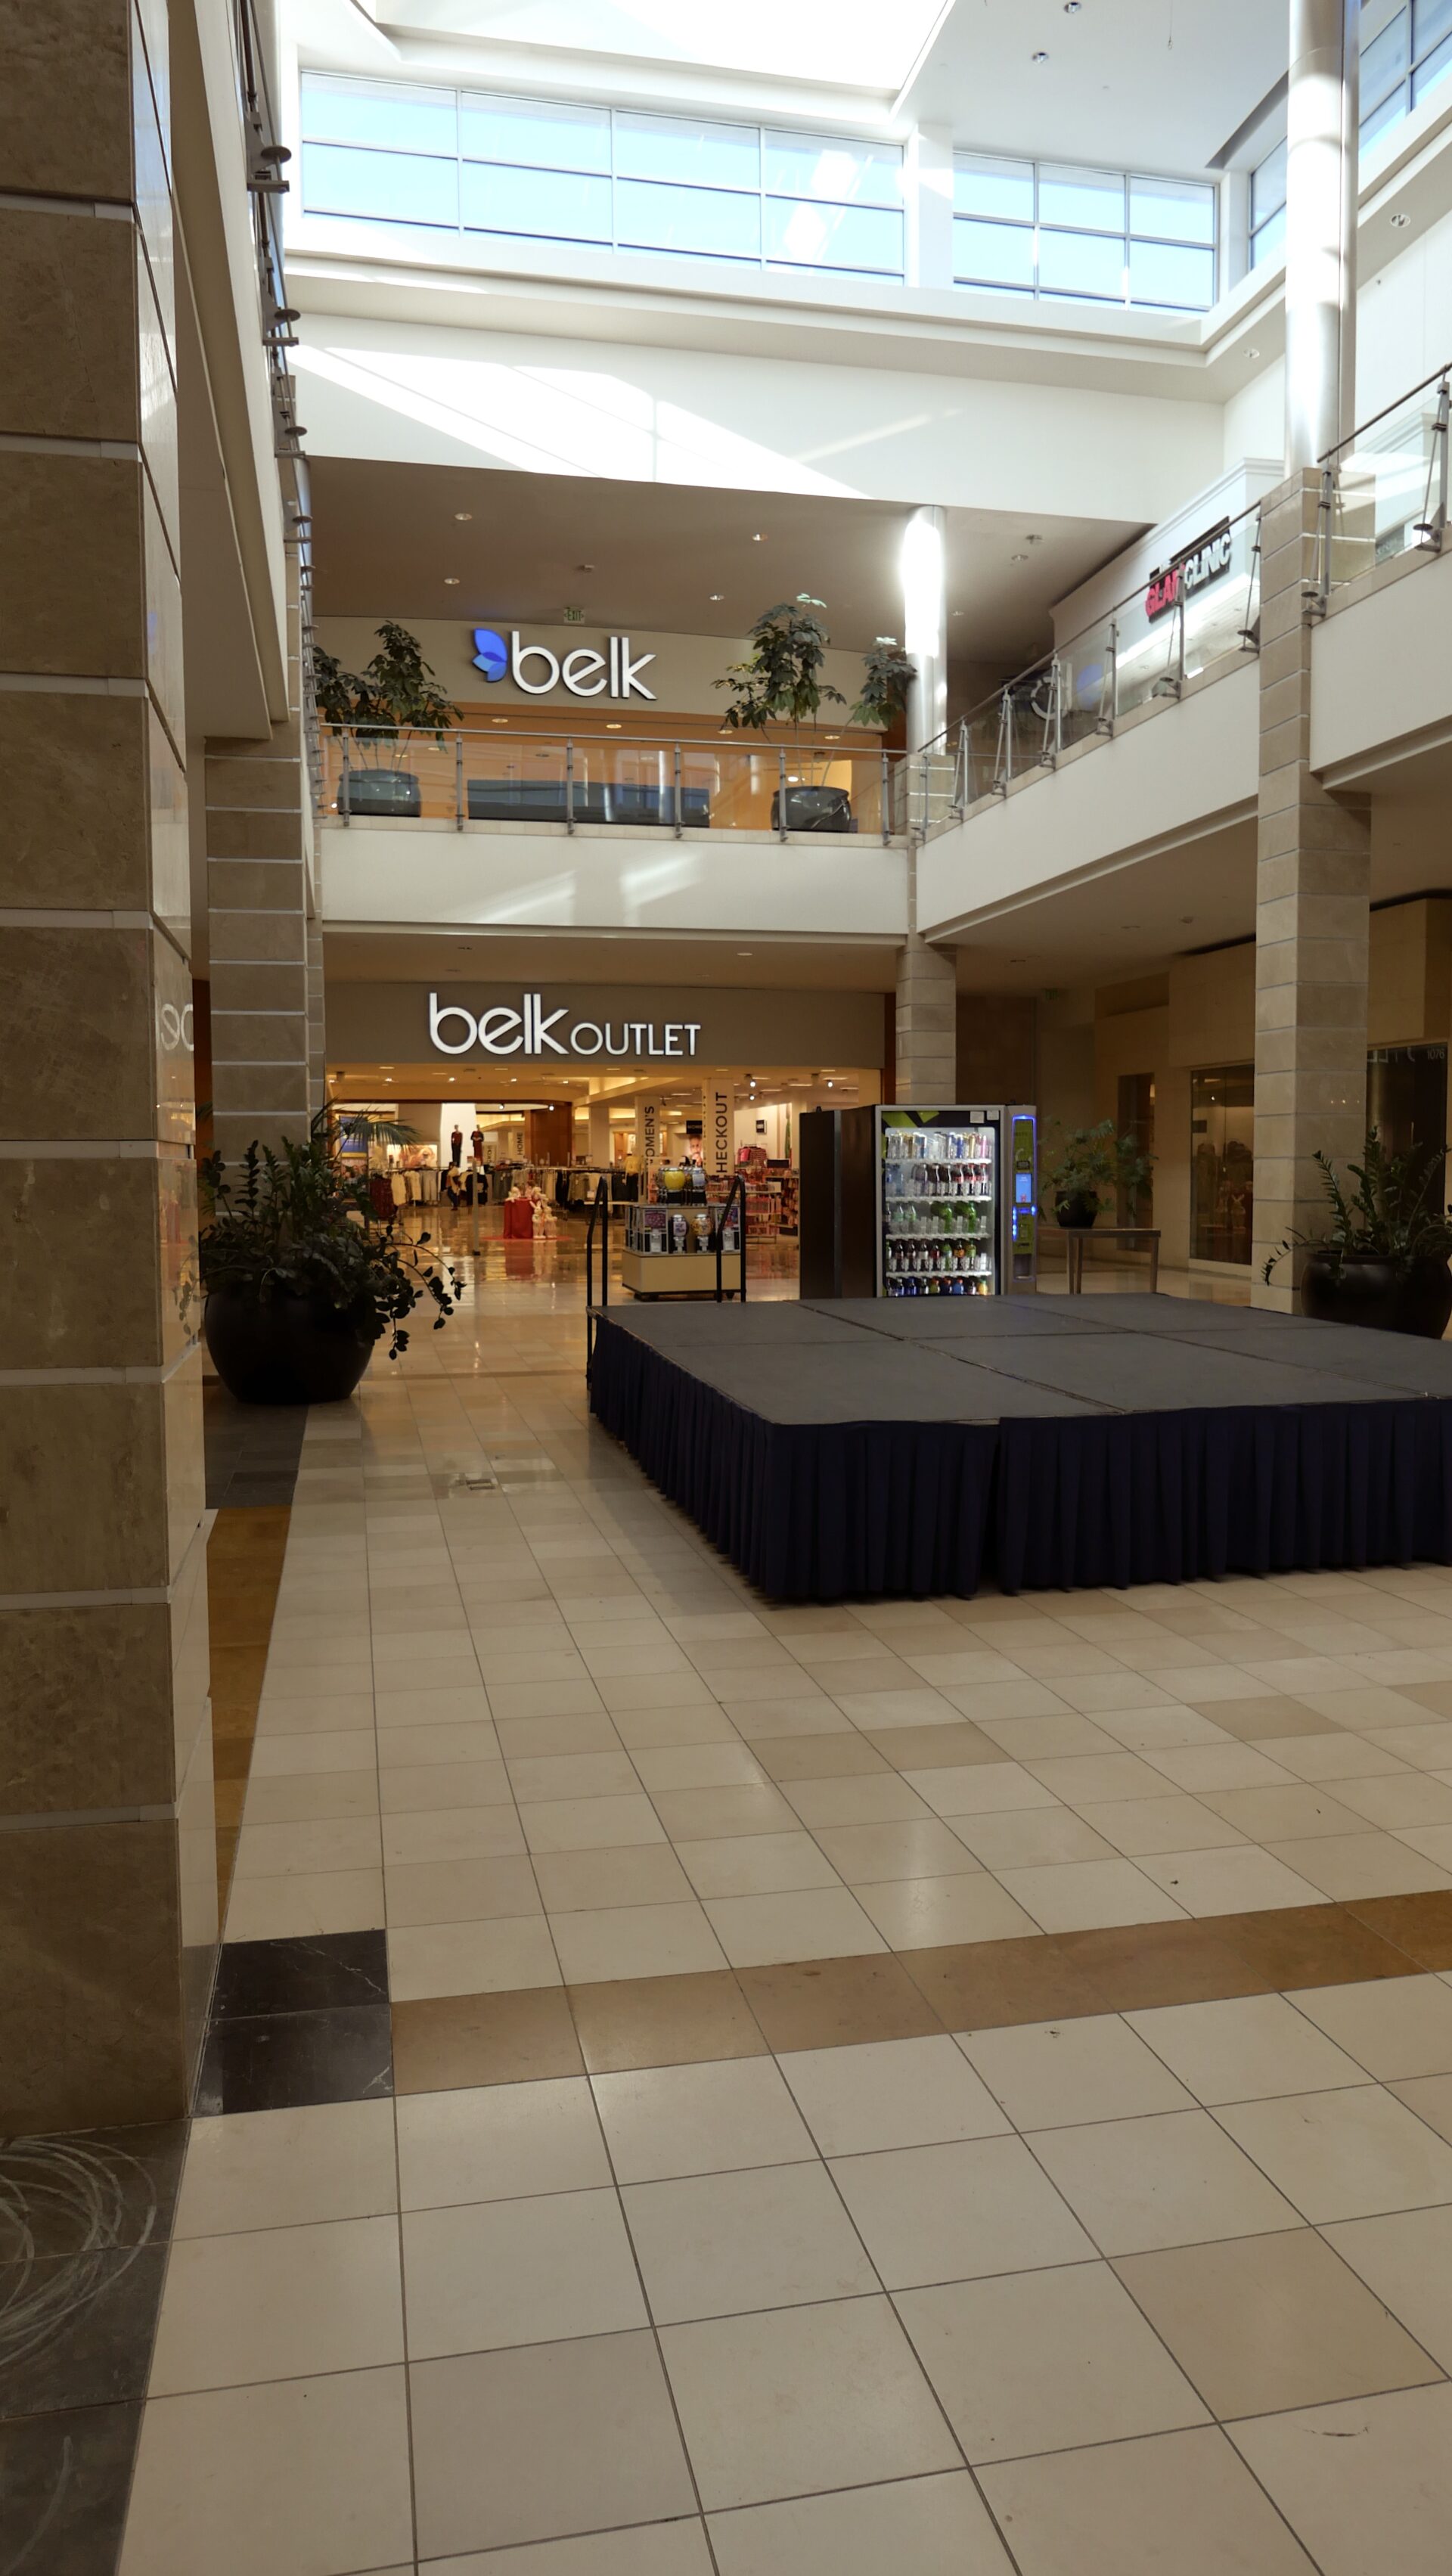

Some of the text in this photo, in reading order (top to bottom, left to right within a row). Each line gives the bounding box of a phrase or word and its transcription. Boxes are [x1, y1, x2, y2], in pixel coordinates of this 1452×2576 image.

[1184, 532, 1231, 590] CLINIC
[567, 610, 582, 621] EXIT
[511, 630, 658, 700] belk
[428, 992, 701, 1057] belk OUTLET
[715, 1091, 728, 1174] HECKOUT
